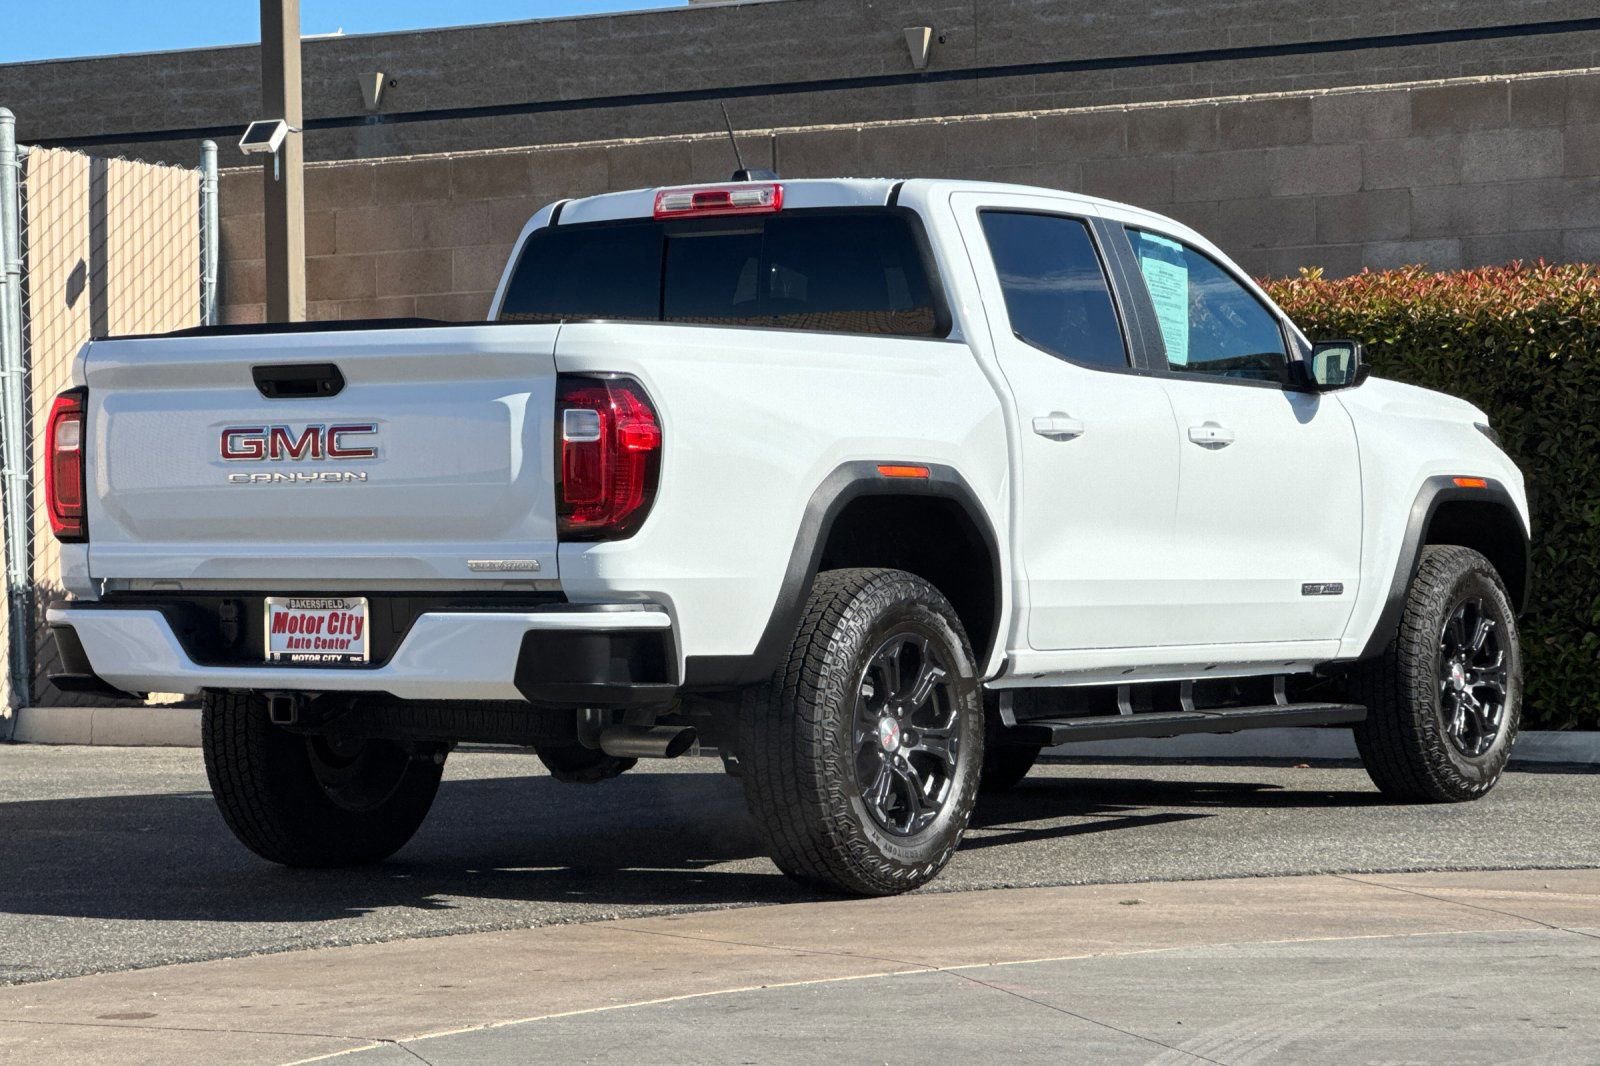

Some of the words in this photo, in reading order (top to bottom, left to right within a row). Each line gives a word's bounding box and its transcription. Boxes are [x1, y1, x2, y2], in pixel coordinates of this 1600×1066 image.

[220, 423, 378, 461] GMC
[228, 471, 367, 484] CANYON
[290, 600, 343, 609] BAKERSFIELD
[272, 612, 325, 634] Motor
[327, 612, 364, 640] City
[287, 636, 312, 649] Auto
[314, 636, 351, 650] Center
[291, 654, 321, 662] MOTOR
[322, 654, 342, 662] CITY
